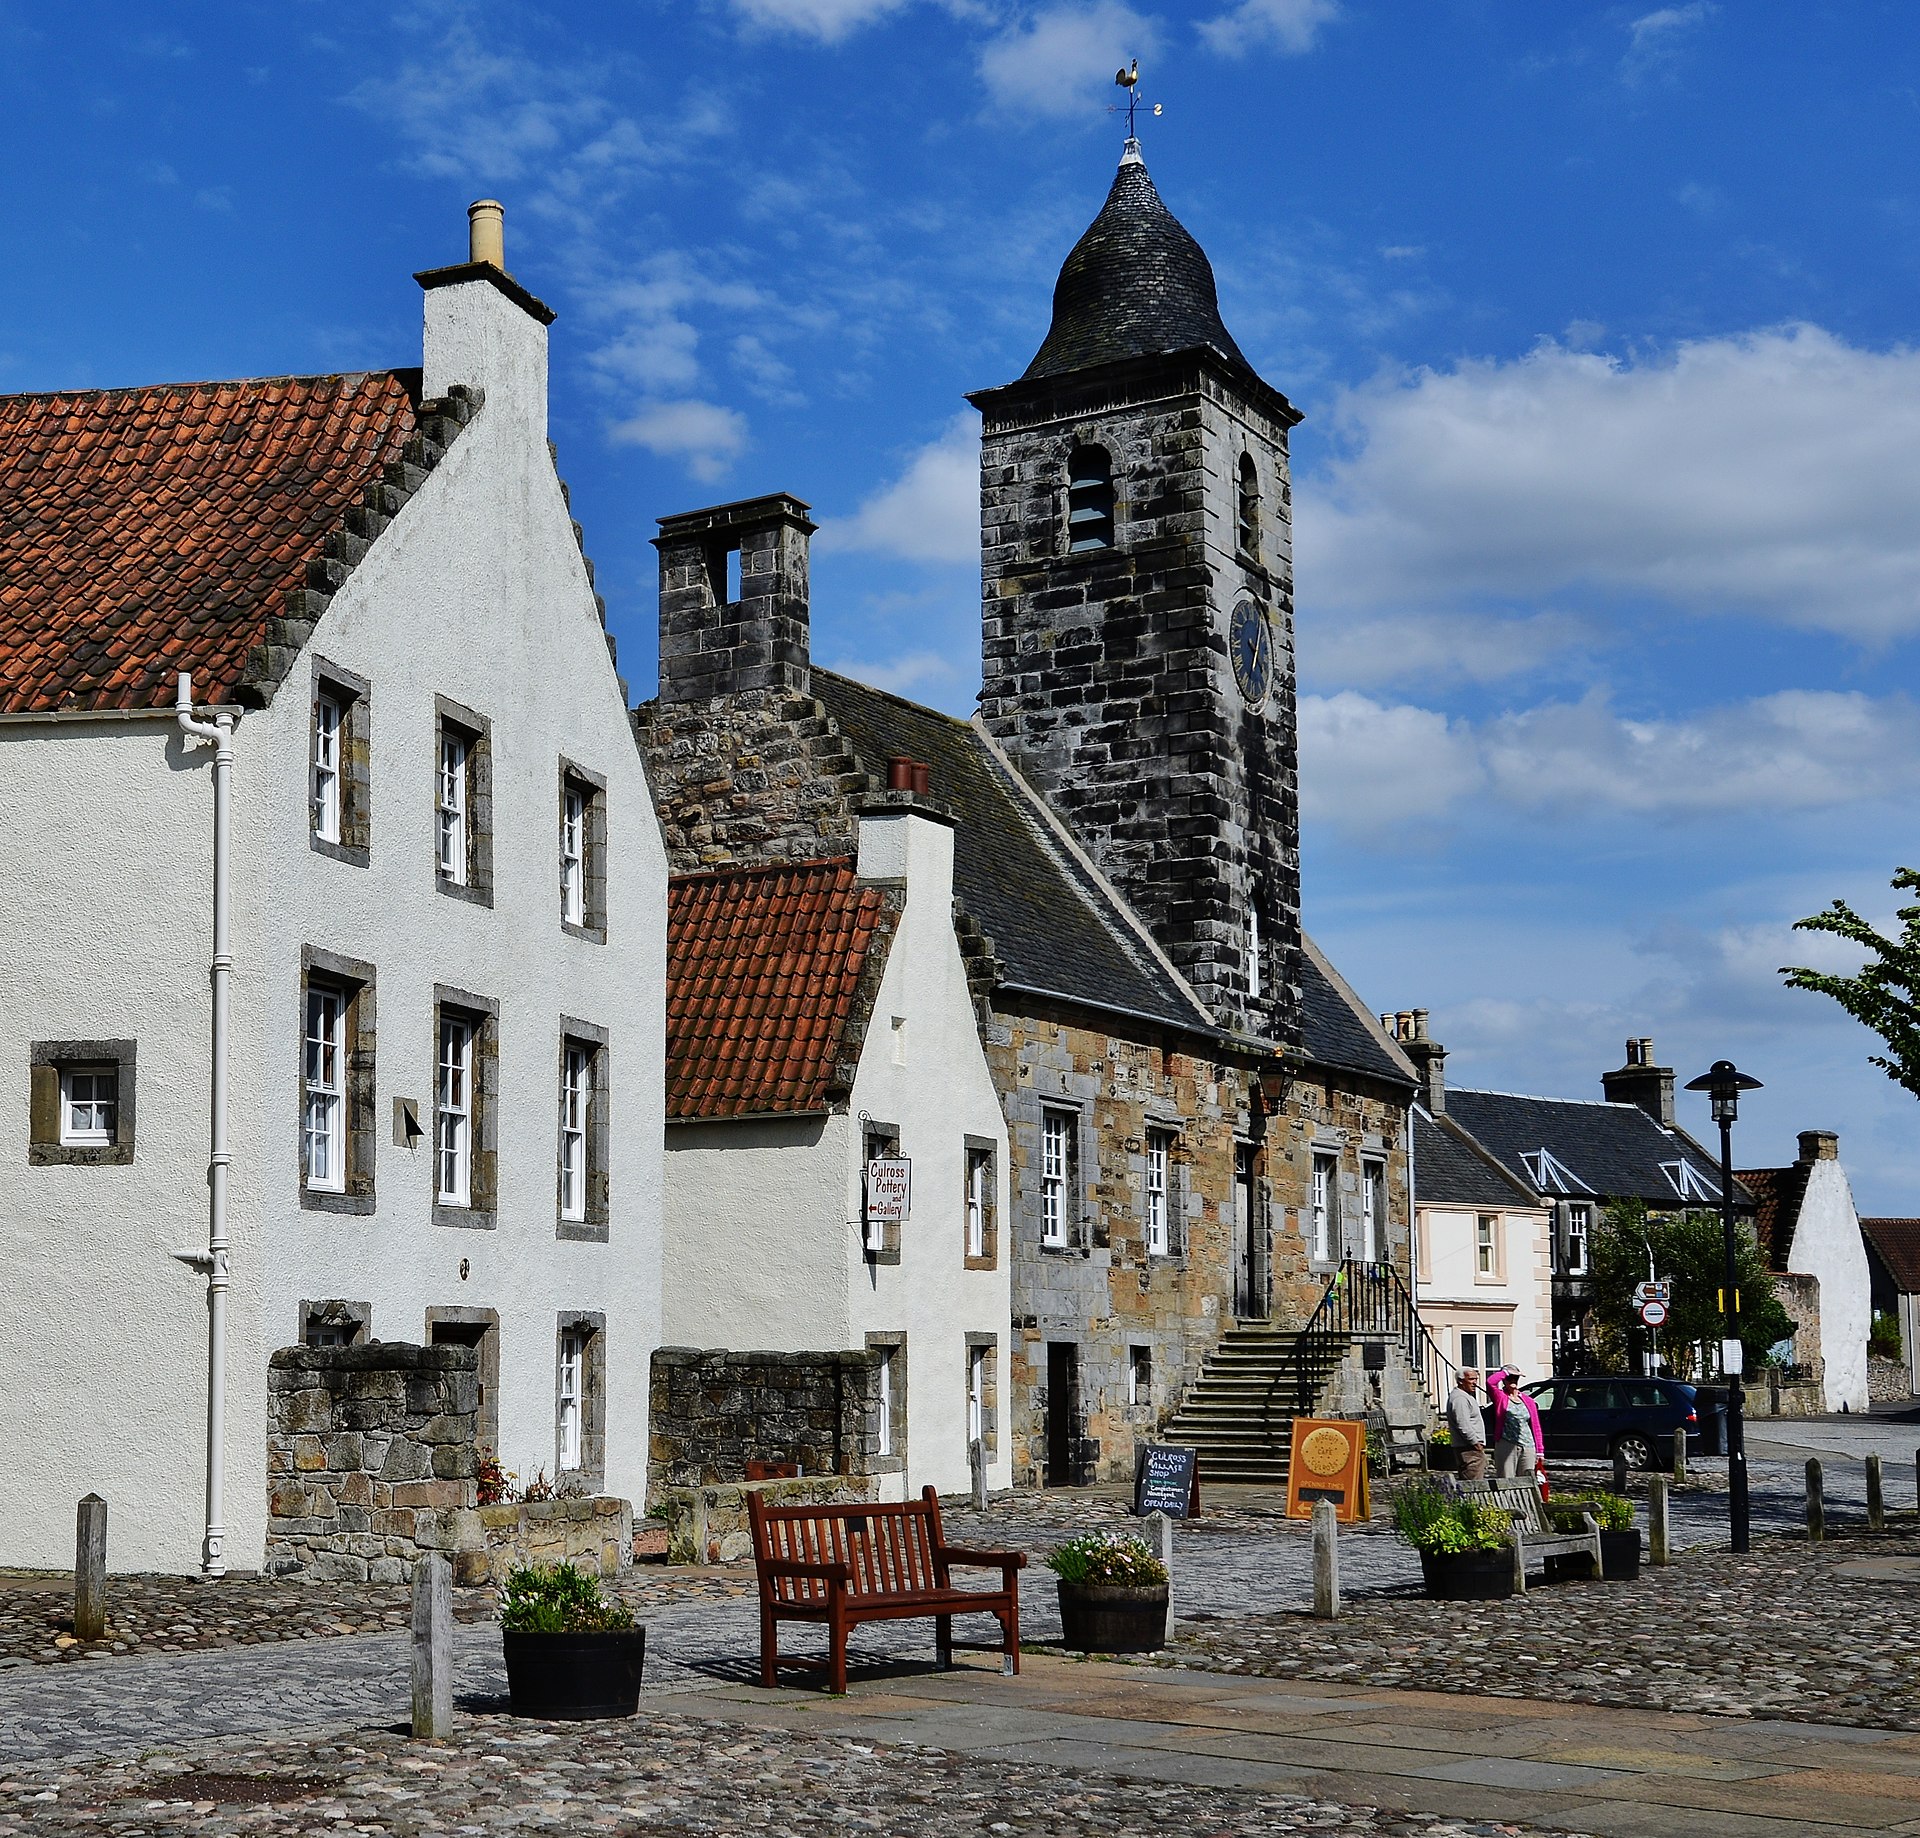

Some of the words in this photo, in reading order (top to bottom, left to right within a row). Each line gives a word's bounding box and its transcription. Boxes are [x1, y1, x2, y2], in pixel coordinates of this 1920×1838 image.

[870, 1162, 905, 1178] Culross
[875, 1177, 907, 1199] Pottery
[892, 1194, 902, 1202] and
[877, 1201, 902, 1219] Gallery
[1151, 1451, 1187, 1464] CULROSS
[1148, 1469, 1170, 1478] SHOP
[1300, 1480, 1325, 1488] OPENING
[1143, 1499, 1163, 1508] OPEN
[1163, 1500, 1183, 1510] DAILY
